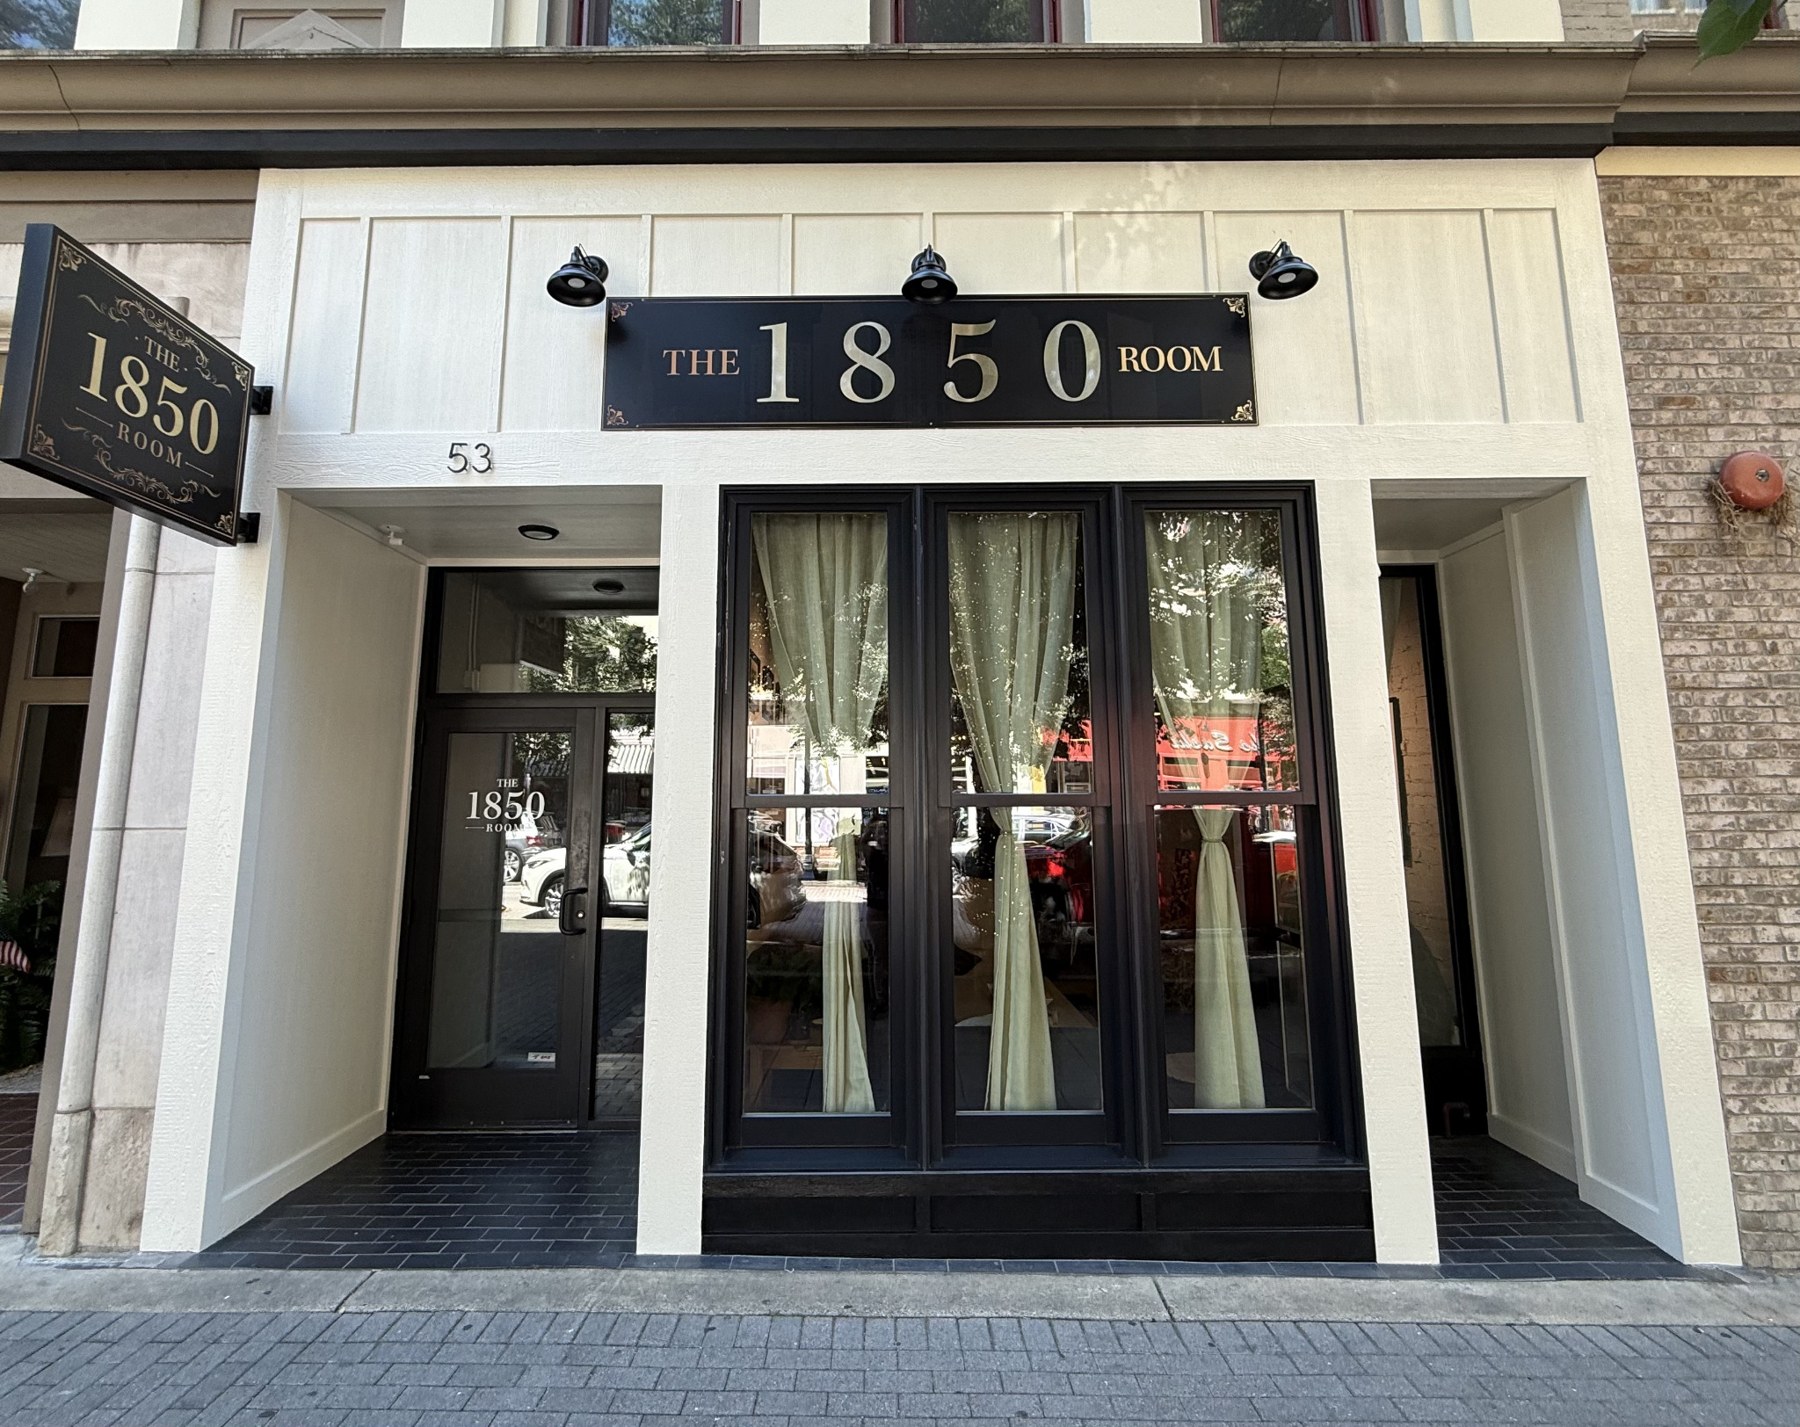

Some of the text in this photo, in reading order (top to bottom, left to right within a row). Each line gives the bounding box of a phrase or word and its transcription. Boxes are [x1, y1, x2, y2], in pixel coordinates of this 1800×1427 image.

[144, 336, 181, 374] THE
[662, 349, 740, 376] THE
[1117, 345, 1224, 373] ROOM
[79, 331, 220, 455] 1850
[116, 421, 184, 469] ROOM
[447, 442, 493, 474] 53
[496, 778, 519, 788] THE
[465, 791, 545, 820] 1850
